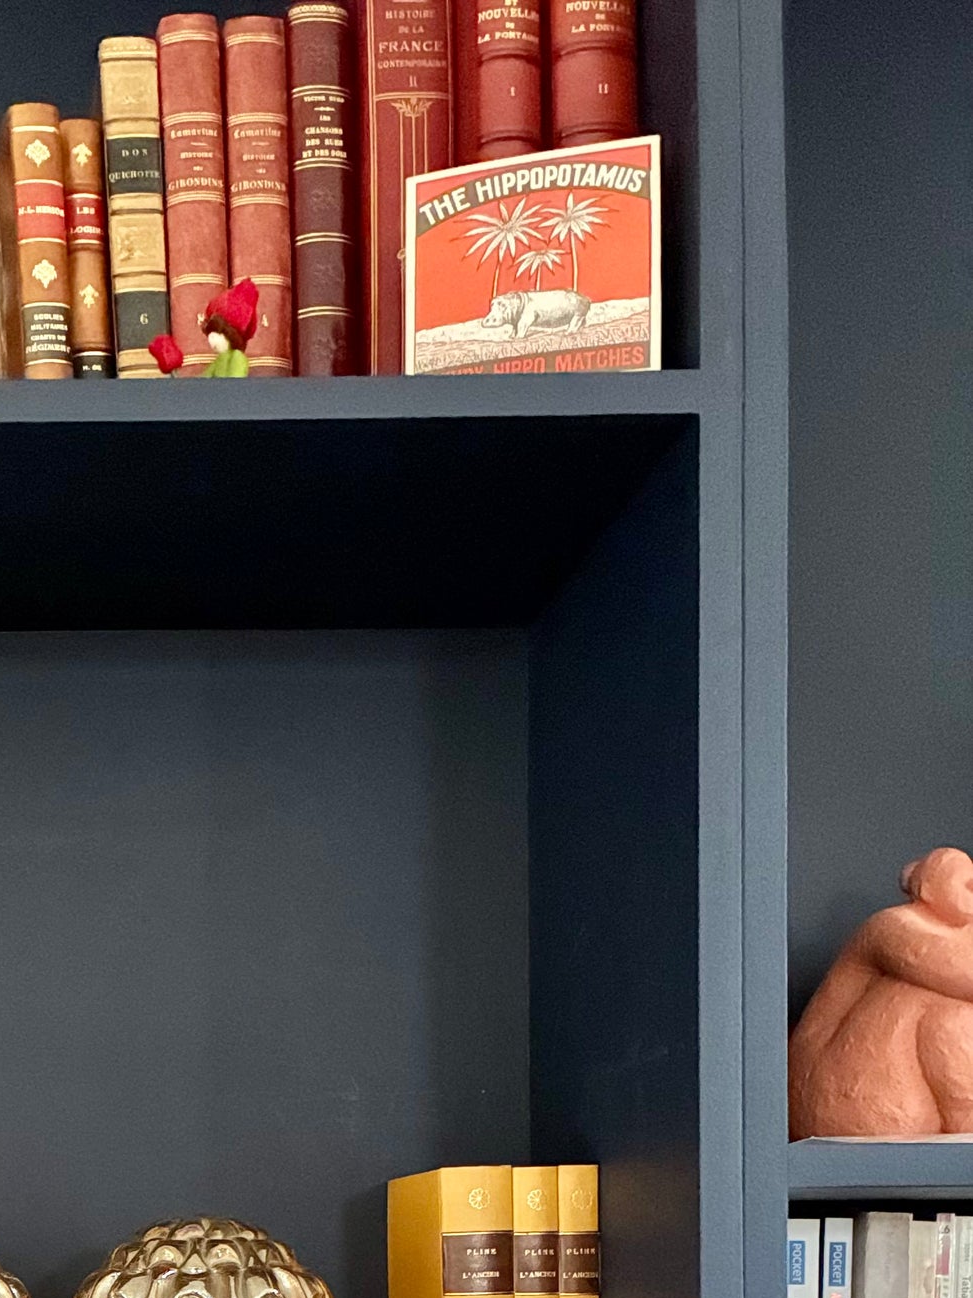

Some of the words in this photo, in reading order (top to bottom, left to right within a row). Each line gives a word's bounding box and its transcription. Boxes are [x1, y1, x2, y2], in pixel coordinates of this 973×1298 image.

[385, 10, 435, 20] HISTOIRE
[398, 25, 410, 34] DE
[412, 25, 424, 34] LA
[379, 40, 443, 54] FRANCE
[169, 177, 224, 190] GIRONDINS
[231, 180, 286, 192] GIRONDINS
[419, 188, 471, 226] THE
[475, 163, 647, 203] HIPPOPOTAMUS
[139, 313, 149, 325] 6
[555, 346, 644, 372] MATCHES
